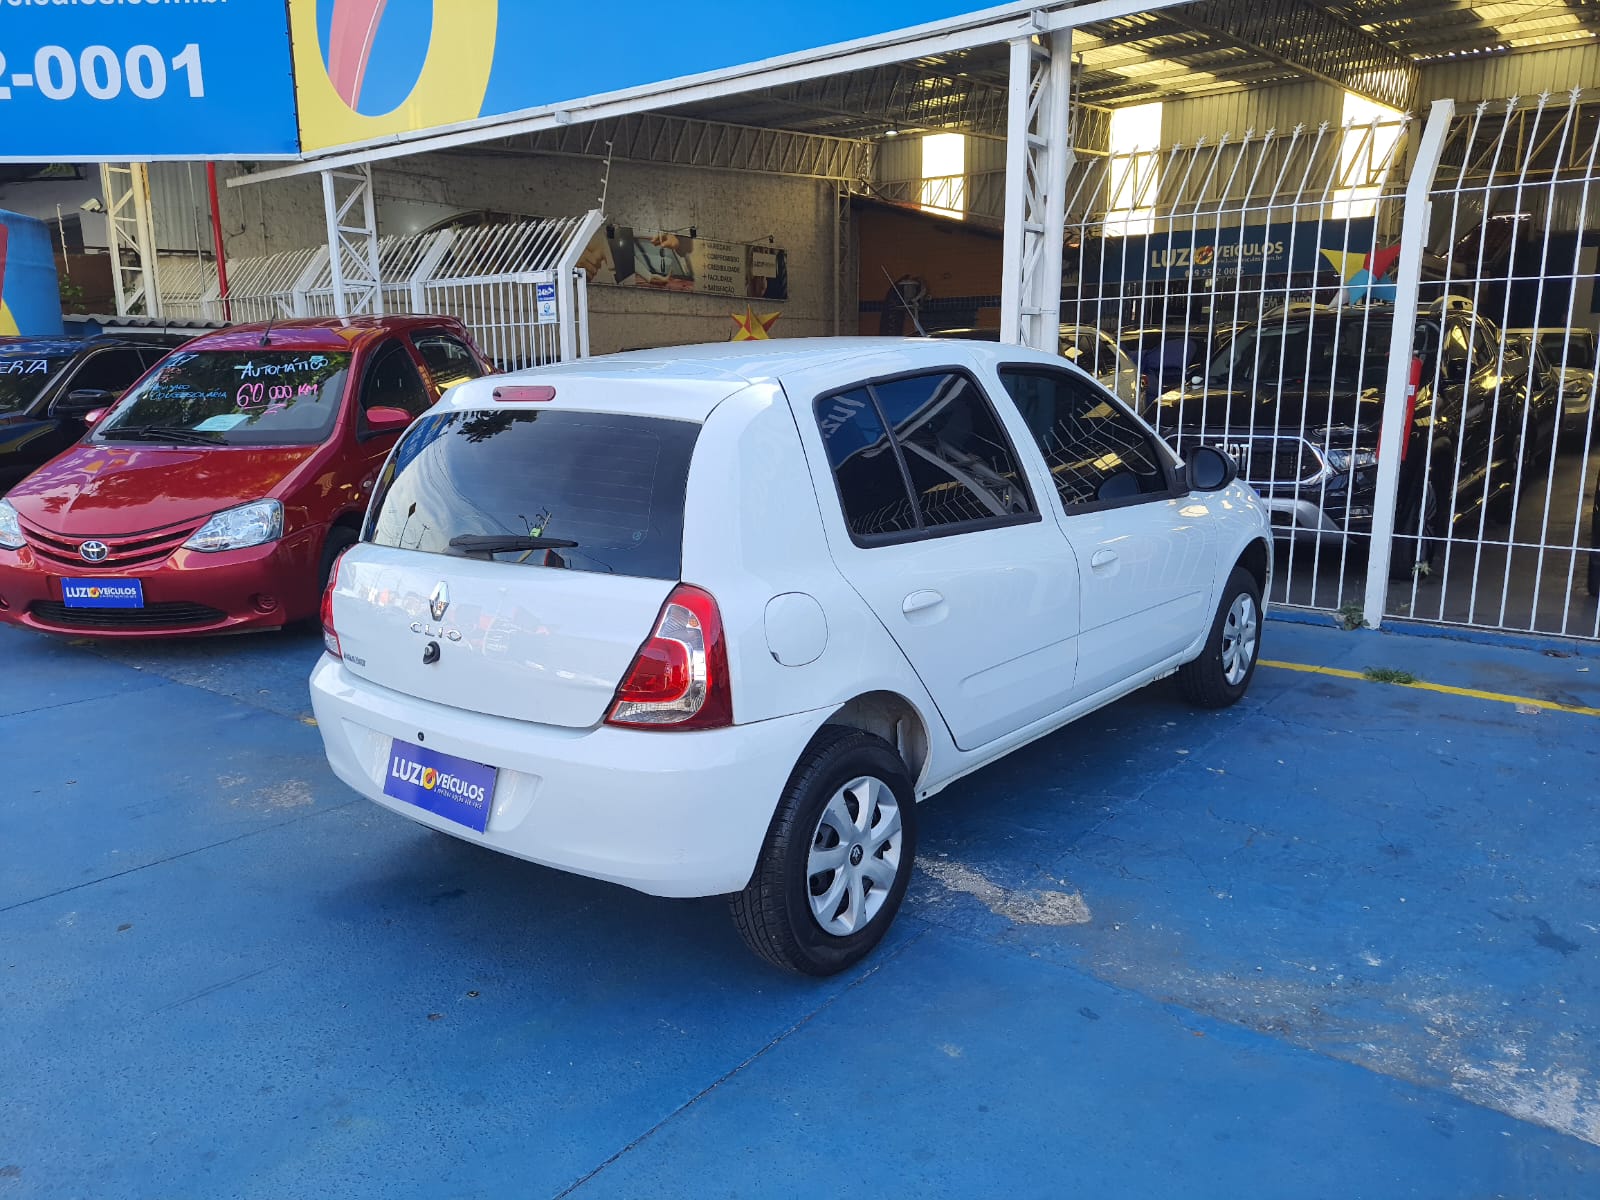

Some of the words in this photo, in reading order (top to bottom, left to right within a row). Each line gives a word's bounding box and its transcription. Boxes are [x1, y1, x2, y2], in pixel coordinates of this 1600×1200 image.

[0, 43, 205, 101] -0001
[1151, 245, 1214, 268] LUZO
[239, 357, 329, 379] AUTOMÁTICO
[237, 382, 264, 407] 60
[269, 385, 293, 399] 000
[298, 382, 319, 396] KM
[65, 586, 100, 599] LUZIO
[99, 586, 137, 596] VEÍCULOS
[410, 621, 462, 641] CLIO
[391, 756, 438, 790] LUZIO
[436, 770, 485, 802] VEÍCULOS
